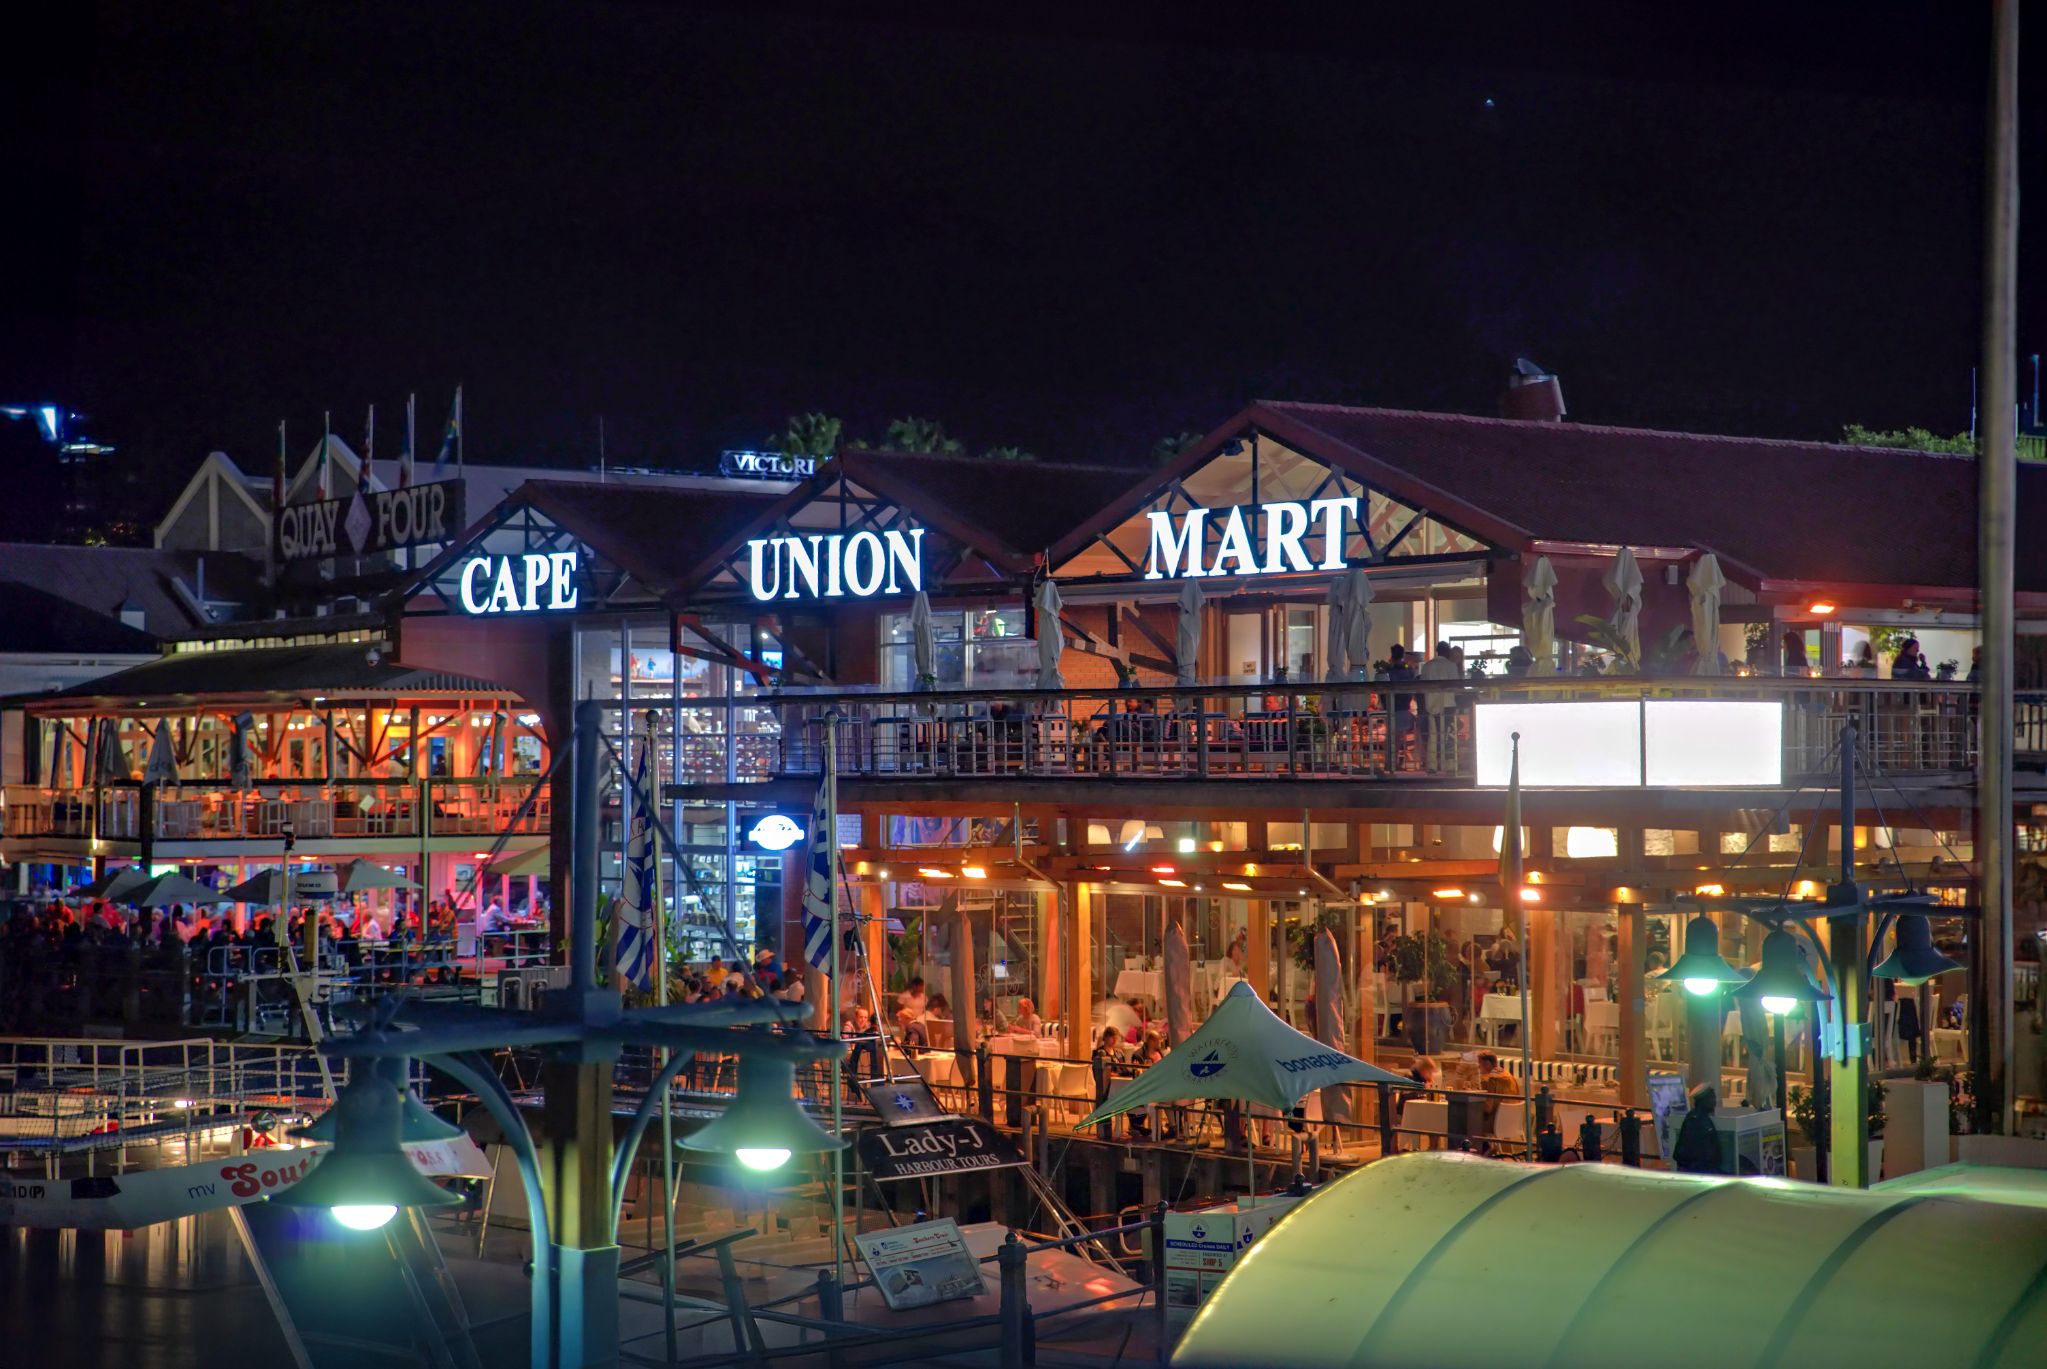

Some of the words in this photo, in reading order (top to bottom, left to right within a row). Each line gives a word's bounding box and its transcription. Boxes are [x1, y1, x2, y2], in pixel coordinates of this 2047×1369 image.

[734, 454, 815, 475] VICTORI
[280, 501, 340, 560] QUAY
[376, 484, 446, 547] FOUR
[1145, 497, 1358, 580] MART
[461, 552, 578, 614] CAPE
[747, 528, 925, 601] UNION
[1276, 1052, 1353, 1074] bonaqua
[877, 1125, 984, 1158] Lady-J
[895, 1157, 957, 1175] HARBOUR
[957, 1153, 1000, 1169] TOURS
[188, 1182, 216, 1200] mv
[220, 1151, 319, 1198] Sout
